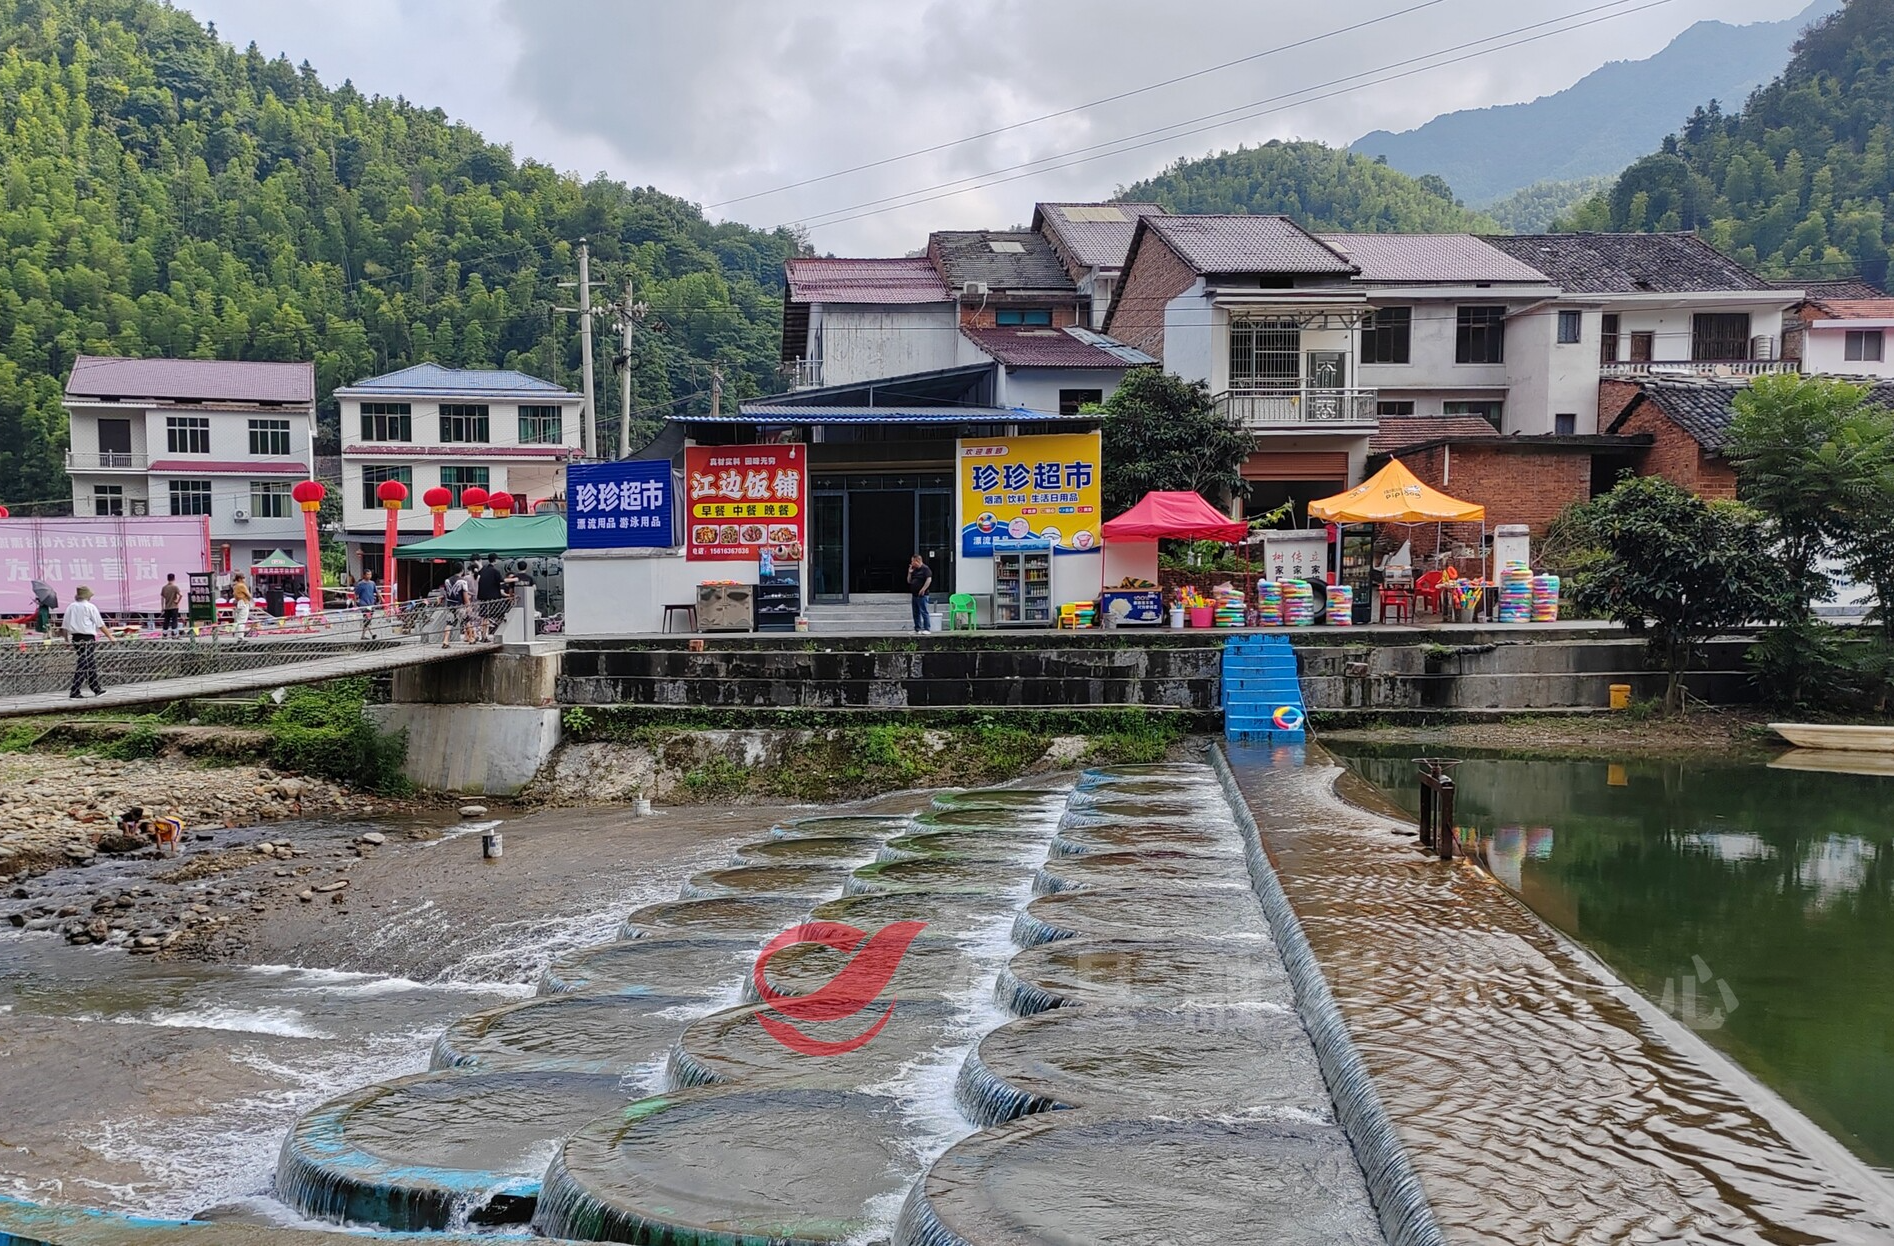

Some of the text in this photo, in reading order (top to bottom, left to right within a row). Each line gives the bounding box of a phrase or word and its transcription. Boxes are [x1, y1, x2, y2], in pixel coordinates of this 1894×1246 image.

[965, 446, 1004, 456] 欢迎惠顾
[745, 456, 777, 466] 回味无穷
[971, 461, 1094, 492] 珍珍超市
[691, 470, 800, 500] 江边饭铺
[576, 479, 664, 514] 珍珍超市
[984, 492, 1079, 505] 烟酒 饮料 生活日用品
[701, 504, 789, 517] 早餐 中餐 晚餐
[576, 515, 662, 530] 漂流用品 游泳用品
